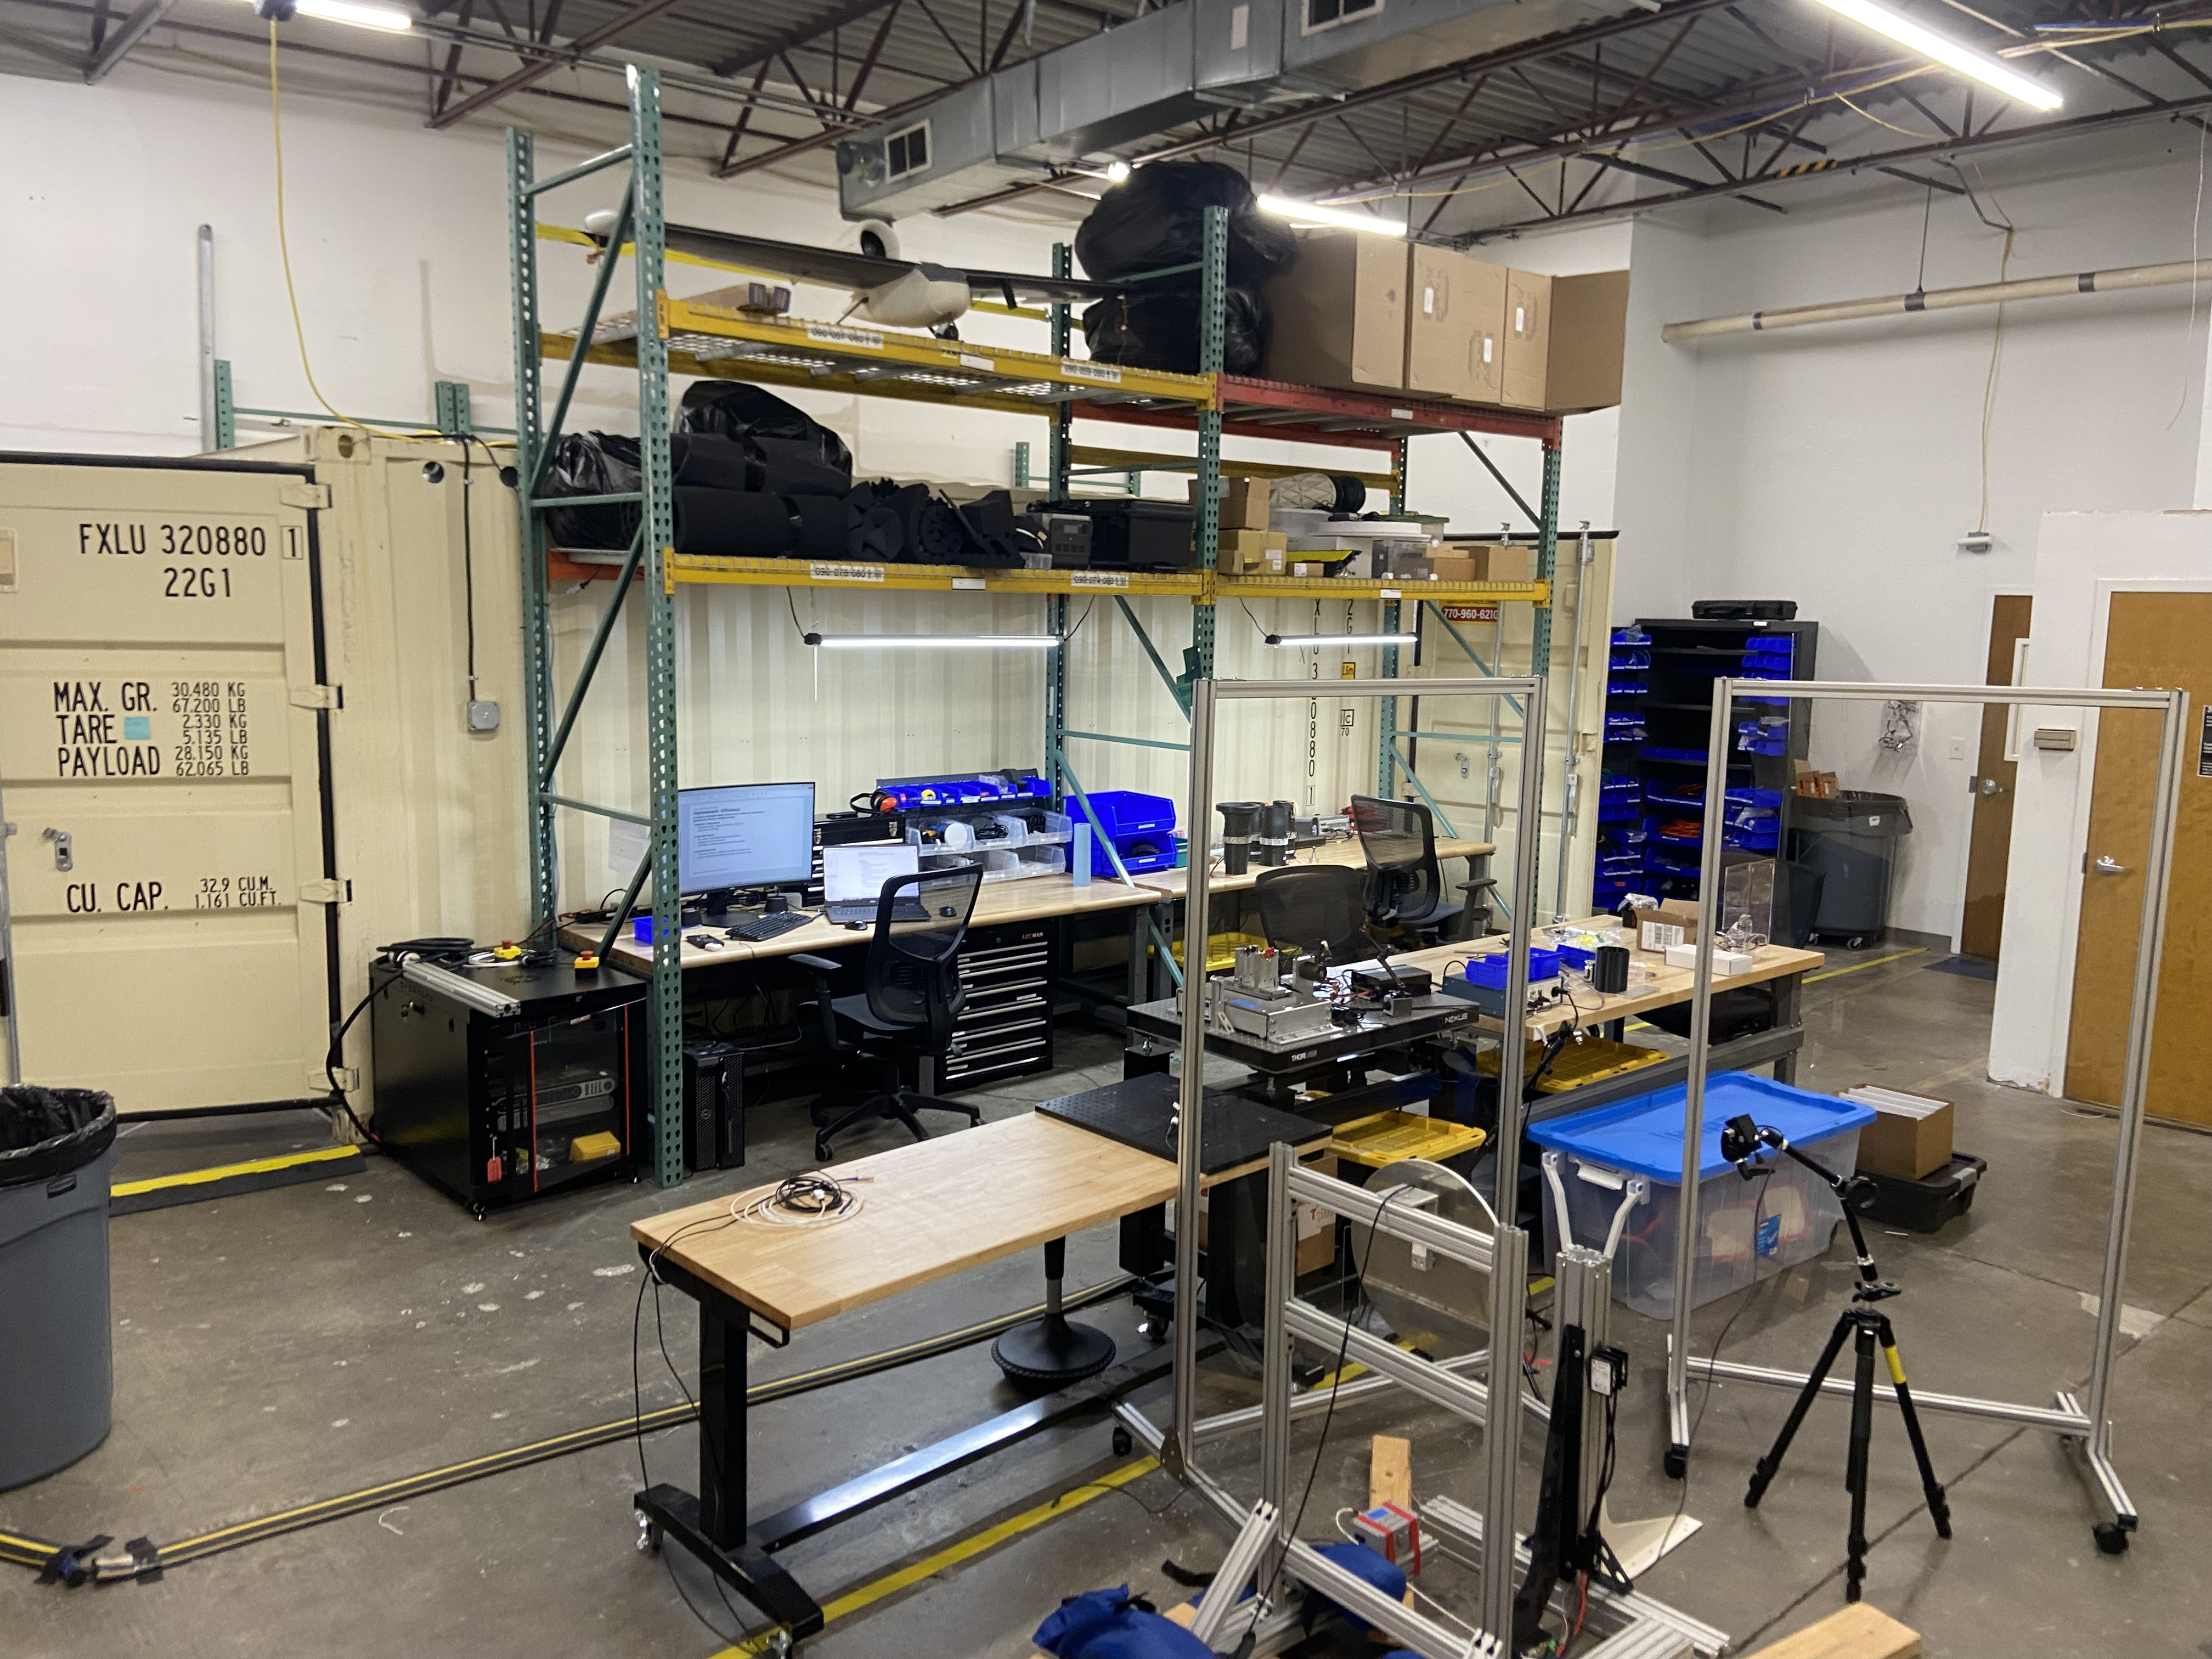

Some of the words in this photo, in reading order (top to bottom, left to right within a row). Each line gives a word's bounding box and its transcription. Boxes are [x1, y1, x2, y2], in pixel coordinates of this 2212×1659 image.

[80, 523, 146, 555] FXLU
[160, 524, 266, 556] 320880
[287, 528, 296, 557] 1
[163, 567, 231, 597] 22G1
[54, 682, 108, 712] MAX.
[121, 682, 157, 711] GR.
[228, 682, 245, 697] KG
[228, 698, 246, 713] LB
[57, 715, 117, 744] TARE
[229, 714, 247, 728] KG
[230, 730, 247, 744] LB
[1341, 727, 1350, 737] 70
[58, 746, 160, 776] PAYLOAD
[231, 745, 249, 760] KG
[232, 761, 249, 775] LB
[67, 883, 101, 913] CU.
[117, 881, 168, 911] CAP.
